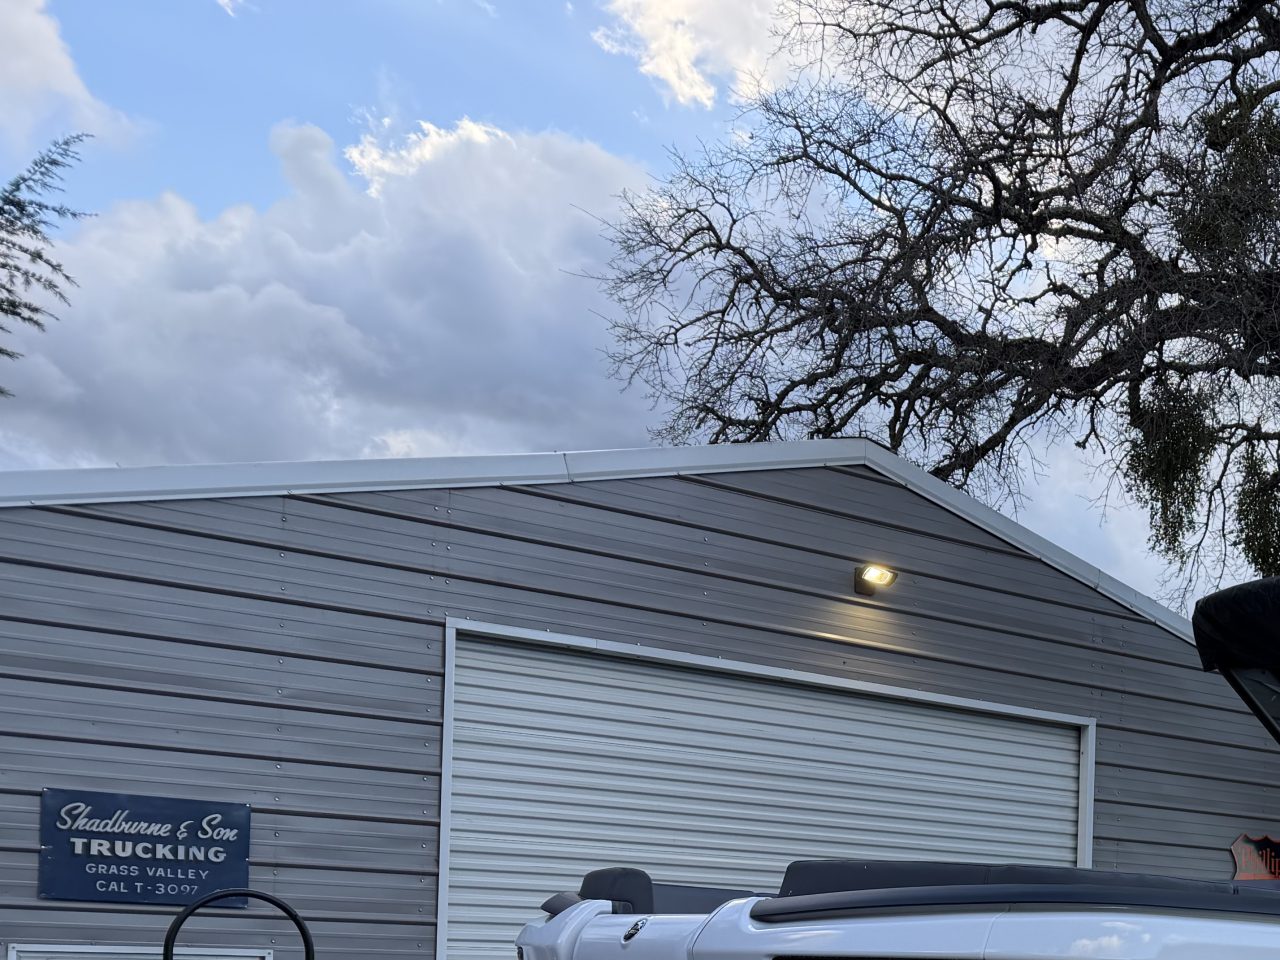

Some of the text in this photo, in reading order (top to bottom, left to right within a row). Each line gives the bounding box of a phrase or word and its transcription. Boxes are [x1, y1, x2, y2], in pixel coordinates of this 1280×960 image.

[56, 802, 239, 842] Shadburne & Son
[70, 837, 227, 863] TRUCKING
[85, 863, 210, 880] GRASS VALLEY
[95, 880, 129, 893] CAL
